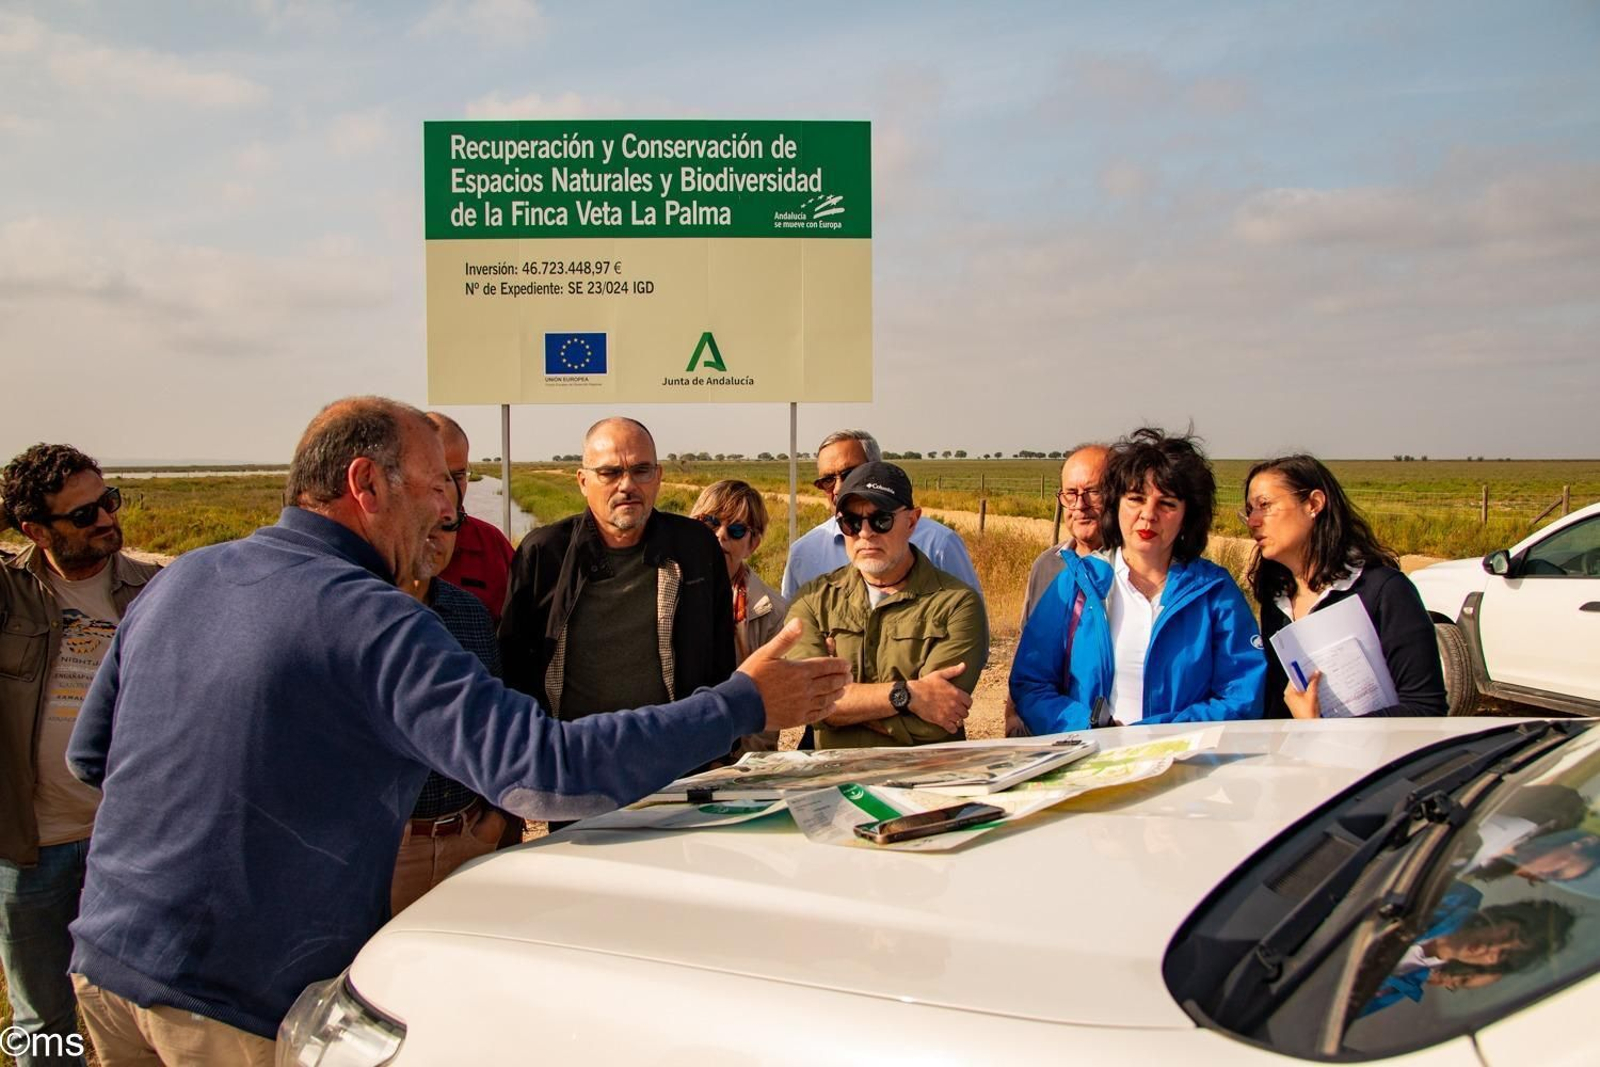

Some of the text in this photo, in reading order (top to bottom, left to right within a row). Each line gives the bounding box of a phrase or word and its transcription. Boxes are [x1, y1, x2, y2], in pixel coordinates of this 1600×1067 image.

[450, 132, 797, 165] Recuperación y Conservación de
[451, 167, 822, 199] Espacios Naturales y Biodiversidad
[450, 200, 731, 226] de la Finca Veta La Palma
[819, 220, 842, 230] Europa
[465, 261, 623, 276] Inversión: 46.723.448,97 €
[483, 282, 497, 295] de
[500, 281, 564, 298] Expediente:
[568, 281, 583, 294] SE
[587, 281, 629, 295] 23/024
[633, 281, 655, 294] IGD
[662, 375, 754, 386] Junta de Andalucía
